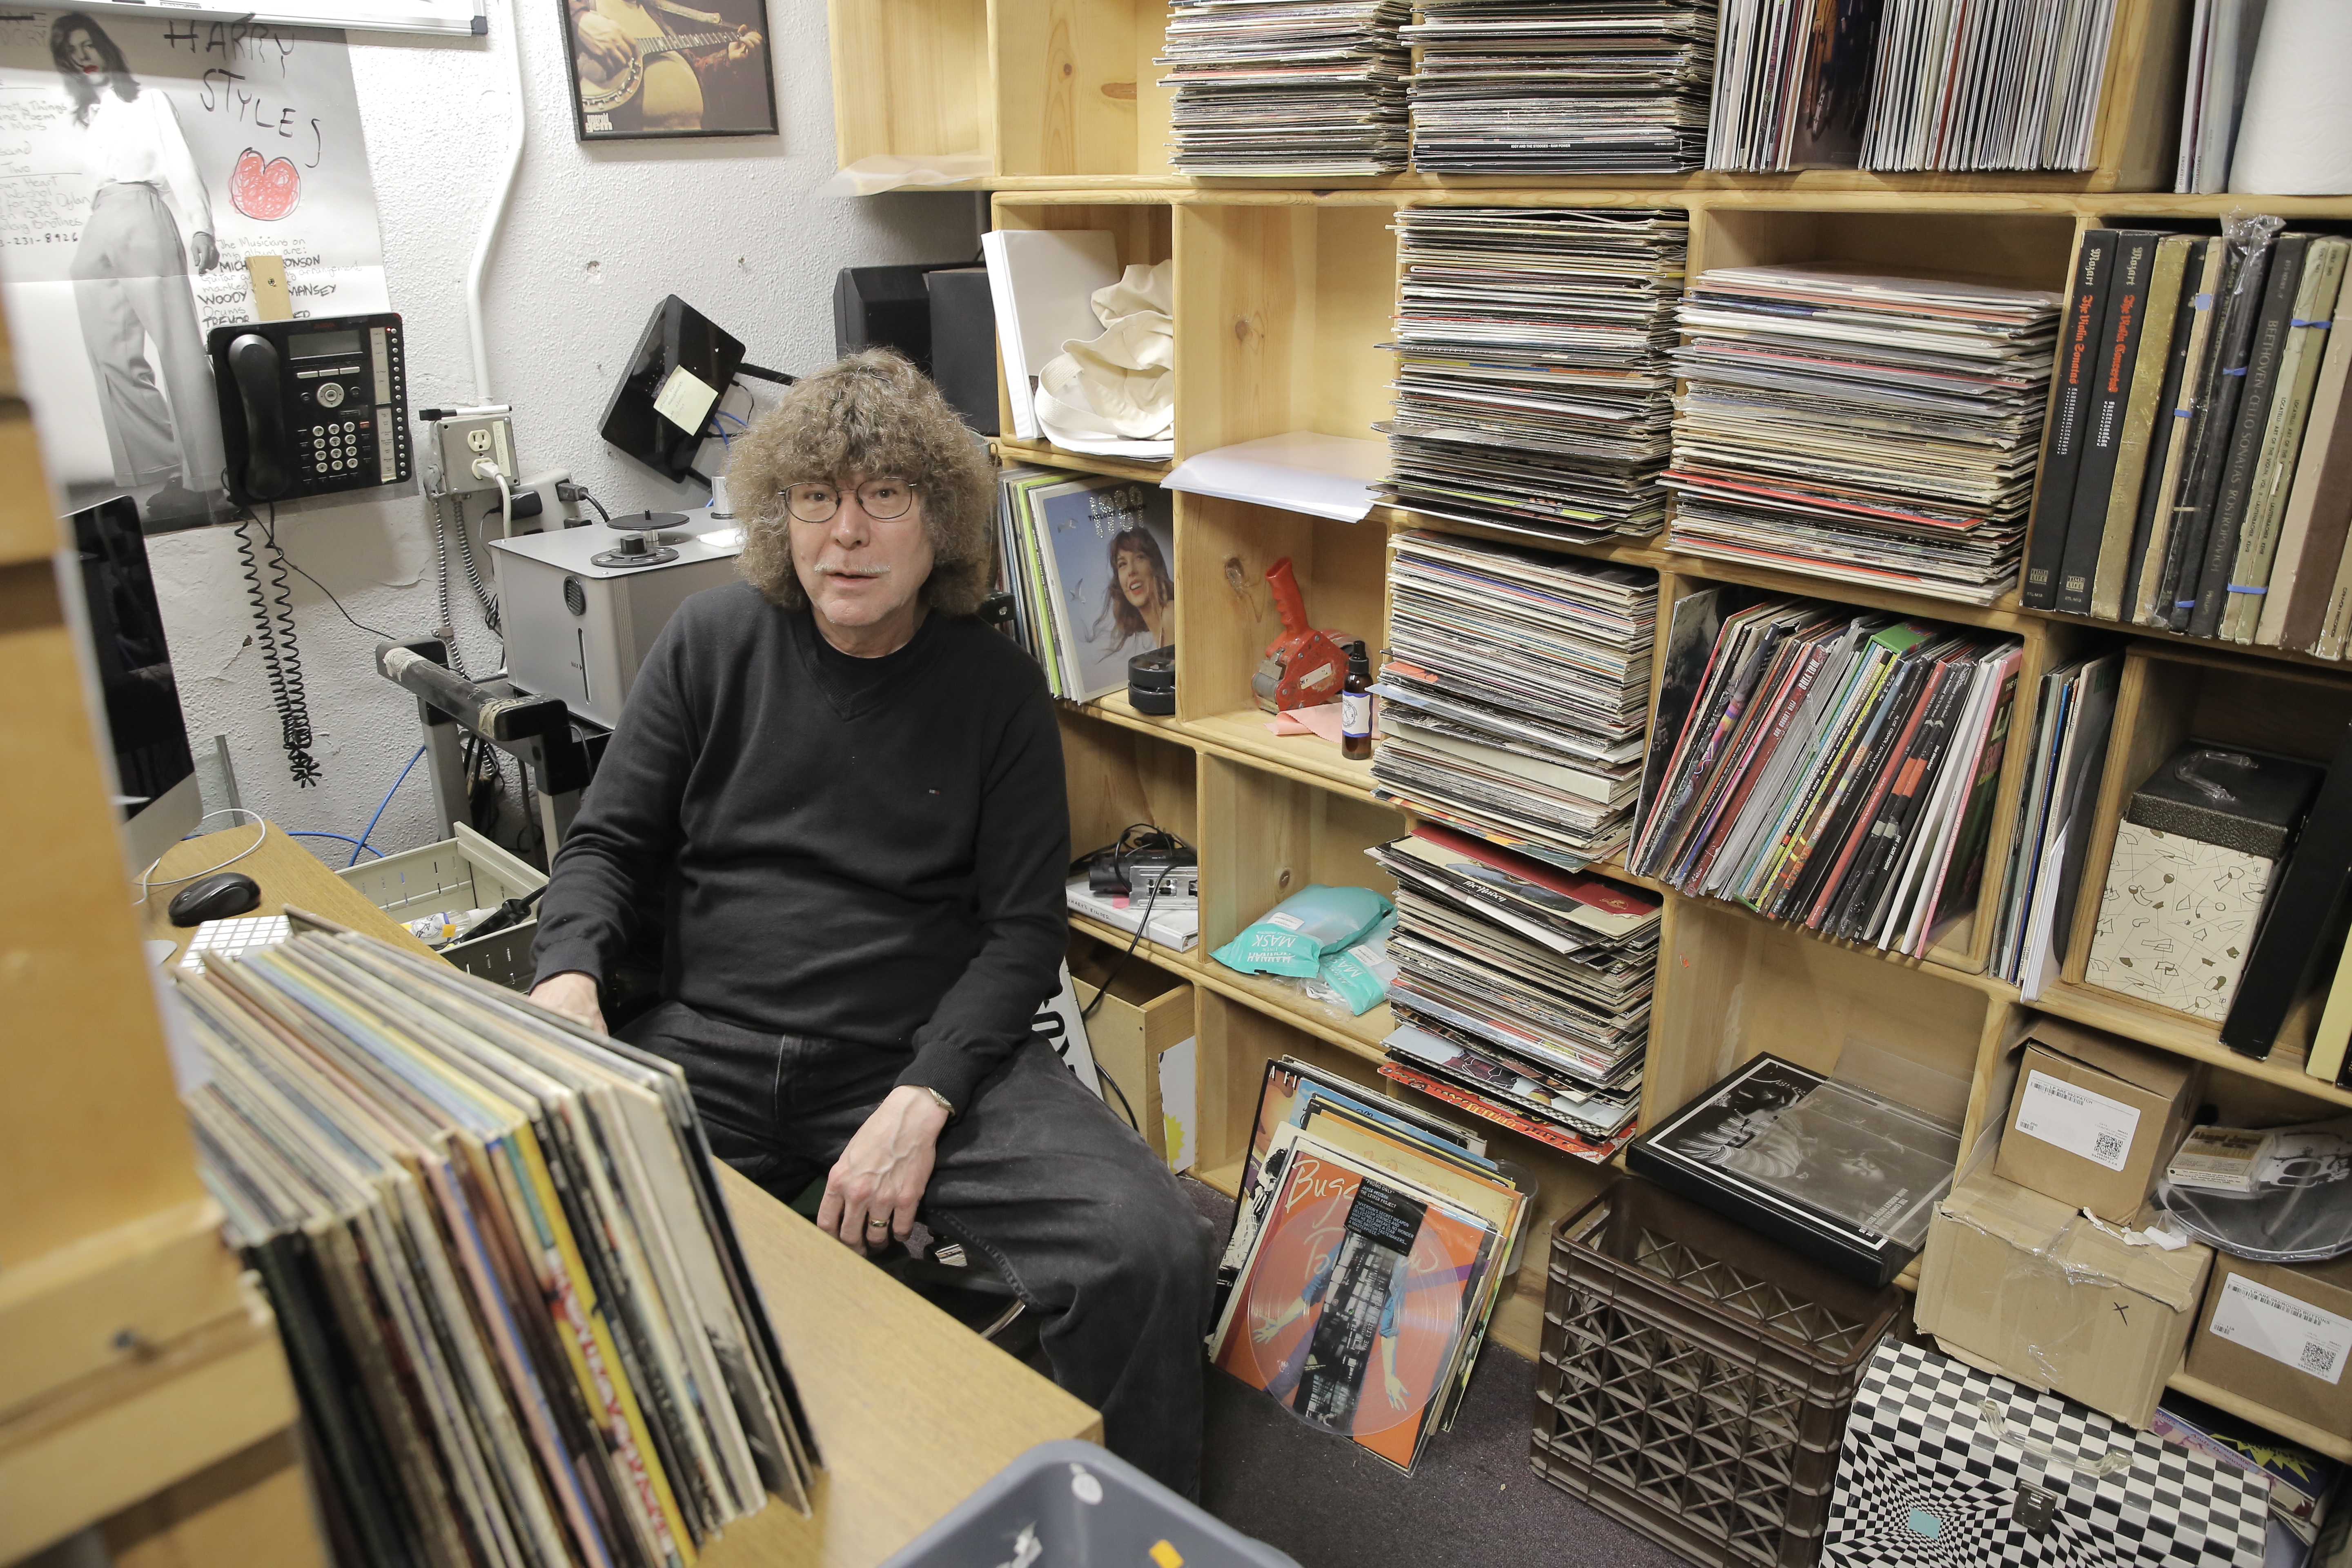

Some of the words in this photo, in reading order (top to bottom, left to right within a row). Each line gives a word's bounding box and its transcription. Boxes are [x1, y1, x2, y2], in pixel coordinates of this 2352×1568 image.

[164, 20, 294, 78] HARRY
[200, 68, 321, 168] STYLES
[587, 113, 609, 122] emerald
[586, 122, 612, 133] gem
[2082, 246, 2101, 287] Mozart
[2123, 245, 2143, 287] Mozart
[197, 292, 247, 305] WOODY
[2078, 293, 2094, 314] The
[2119, 293, 2136, 315] The
[203, 306, 246, 317] Drums
[2074, 314, 2090, 343] Violin
[2116, 313, 2132, 343] Violin
[2252, 318, 2279, 389] BEETHOVEN
[2067, 342, 2085, 385] Sonatas
[2243, 394, 2261, 430] CELLO
[2230, 432, 2252, 484] SONATAS
[2262, 458, 2272, 477] VIOLIN,
[1089, 486, 1144, 538] 1989
[2209, 488, 2238, 572] ROSTROPOVICH
[2257, 542, 2265, 555] KEHR
[1891, 714, 1900, 727] ALICE
[1882, 727, 1893, 744] COOPER
[1977, 734, 1985, 749] FLAMING
[1851, 745, 1866, 766] SUSTO
[1925, 752, 1937, 771] Weeknd
[1827, 793, 1840, 809] TIME
[1817, 813, 1829, 828] THE
[1810, 826, 1822, 841] SUN
[1946, 836, 1955, 852] FORUM,
[1941, 852, 1951, 870] LONDON,
[1252, 934, 1296, 948] MASK
[1269, 1065, 1276, 1080] A
[2067, 1092, 2093, 1104] 092/PATCH
[1381, 1198, 1396, 1208] PROJECT
[1350, 1216, 1363, 1225] AMONG
[1363, 1222, 1378, 1232] BRITISH
[1353, 1209, 1376, 1221] DELECTABLE
[1397, 1228, 1414, 1238] WONDER
[1366, 1219, 1381, 1228] BECAME
[1376, 1214, 1391, 1224] STRINGS
[1379, 1211, 1393, 1220] SECRET
[1393, 1217, 1409, 1227] WEAPON
[2271, 1298, 2301, 1312] 092/ROUND
[2303, 1310, 2330, 1324] BUTTONS
